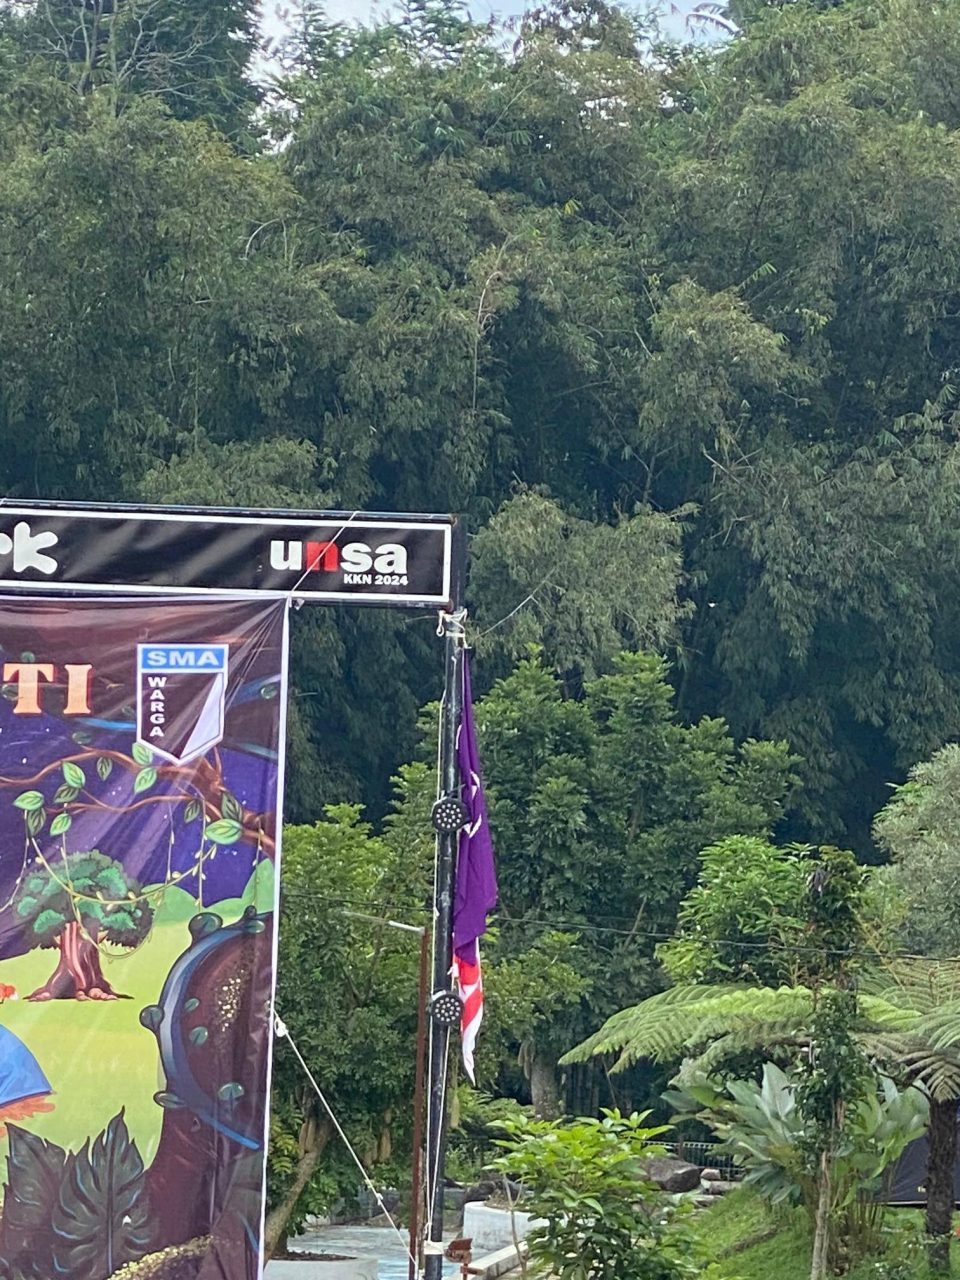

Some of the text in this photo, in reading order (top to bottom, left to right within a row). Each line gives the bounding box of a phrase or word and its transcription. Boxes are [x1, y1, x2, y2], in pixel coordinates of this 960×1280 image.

[270, 540, 408, 575] unsa
[343, 574, 409, 586] KKN 2024
[147, 650, 220, 667] SMA
[147, 676, 167, 737] WARGA
